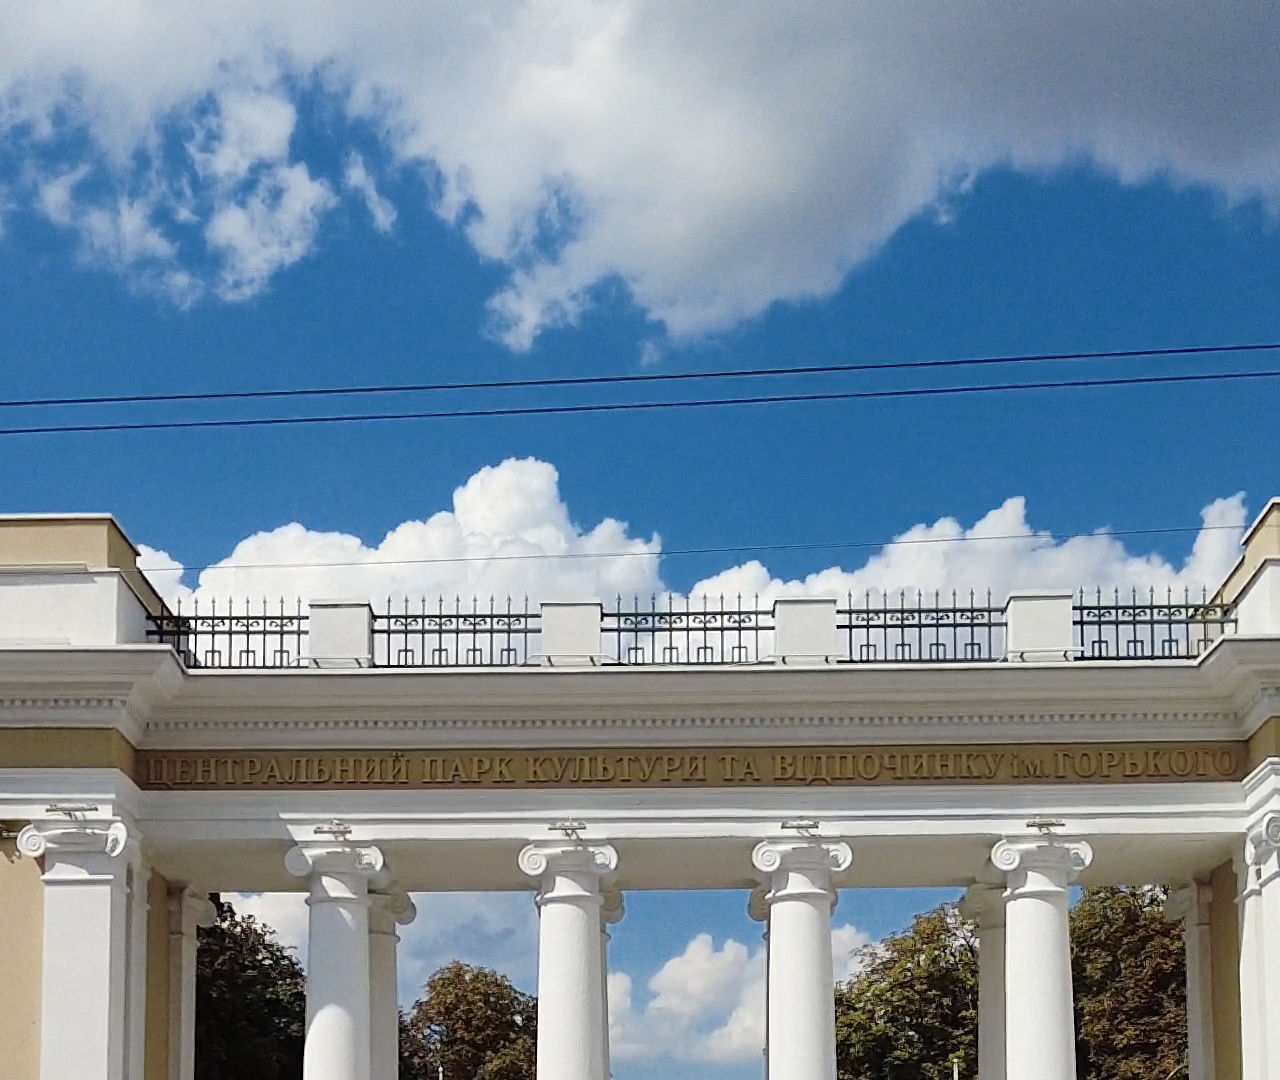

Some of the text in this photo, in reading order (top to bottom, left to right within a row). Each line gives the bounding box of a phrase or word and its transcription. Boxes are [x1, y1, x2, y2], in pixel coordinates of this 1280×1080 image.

[146, 753, 410, 786] ЦЕНТРАЛЬНИЙ
[421, 756, 516, 784] ПАРК
[525, 755, 707, 783] КУЛЬТУРИ
[718, 755, 762, 783] ТА
[773, 753, 1005, 786] ВІДПОЧИНКУ
